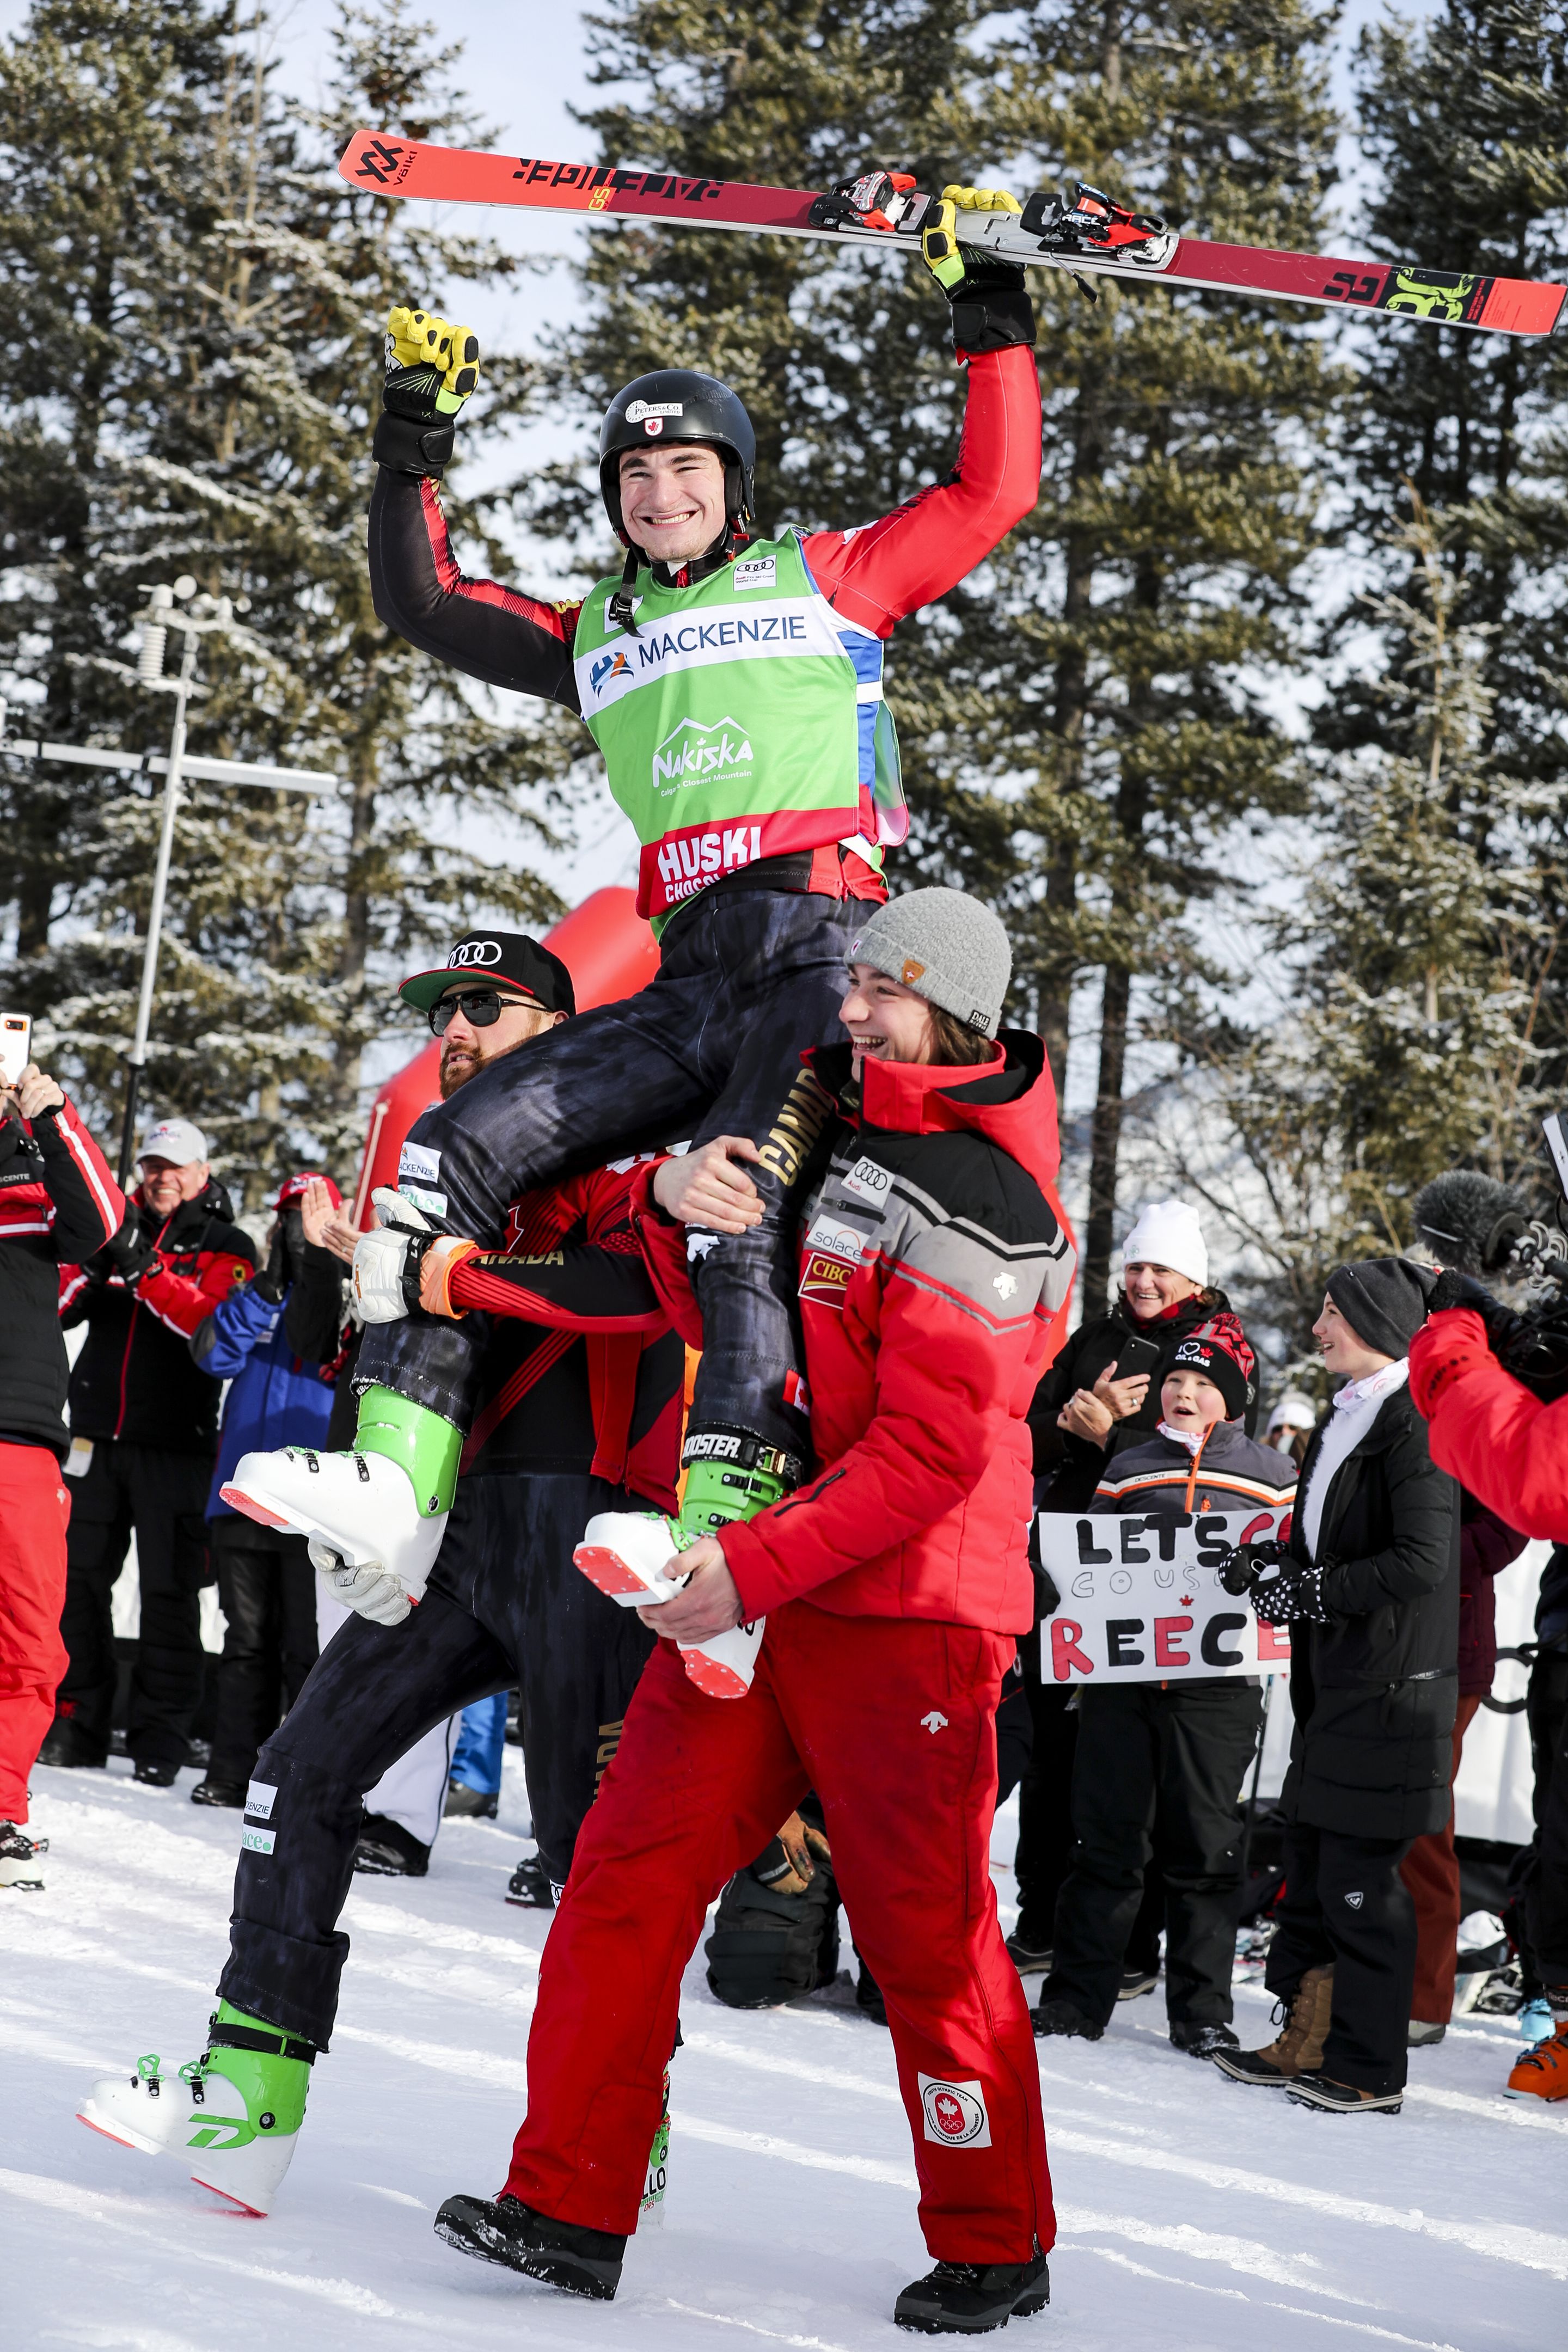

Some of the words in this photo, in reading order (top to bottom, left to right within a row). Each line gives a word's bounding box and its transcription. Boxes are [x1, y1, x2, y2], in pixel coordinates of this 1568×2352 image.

[589, 187, 610, 211] GS
[638, 615, 807, 668] MACKENZIE
[683, 776, 711, 787] Closest
[713, 770, 752, 782] Mountain
[657, 826, 762, 883] HUSKI
[758, 1068, 834, 1186] CANAD
[399, 1162, 436, 1178] ACKENZIE
[847, 1180, 861, 1191] Audi
[469, 1250, 564, 1266] ANADA
[813, 1231, 862, 1261] solace
[812, 1260, 852, 1284] CIBC
[1192, 1355, 1210, 1367] GAS
[1135, 1473, 1165, 1483] DESCENTE
[1051, 1613, 1291, 1682] REECE
[927, 2087, 937, 2096] YOUTH
[937, 2086, 955, 2095] OLYMPIC
[956, 2092, 969, 2102] TEAM
[934, 2124, 955, 2140] OLYMPIQUE
[969, 2113, 979, 2134] JEUNESSE
